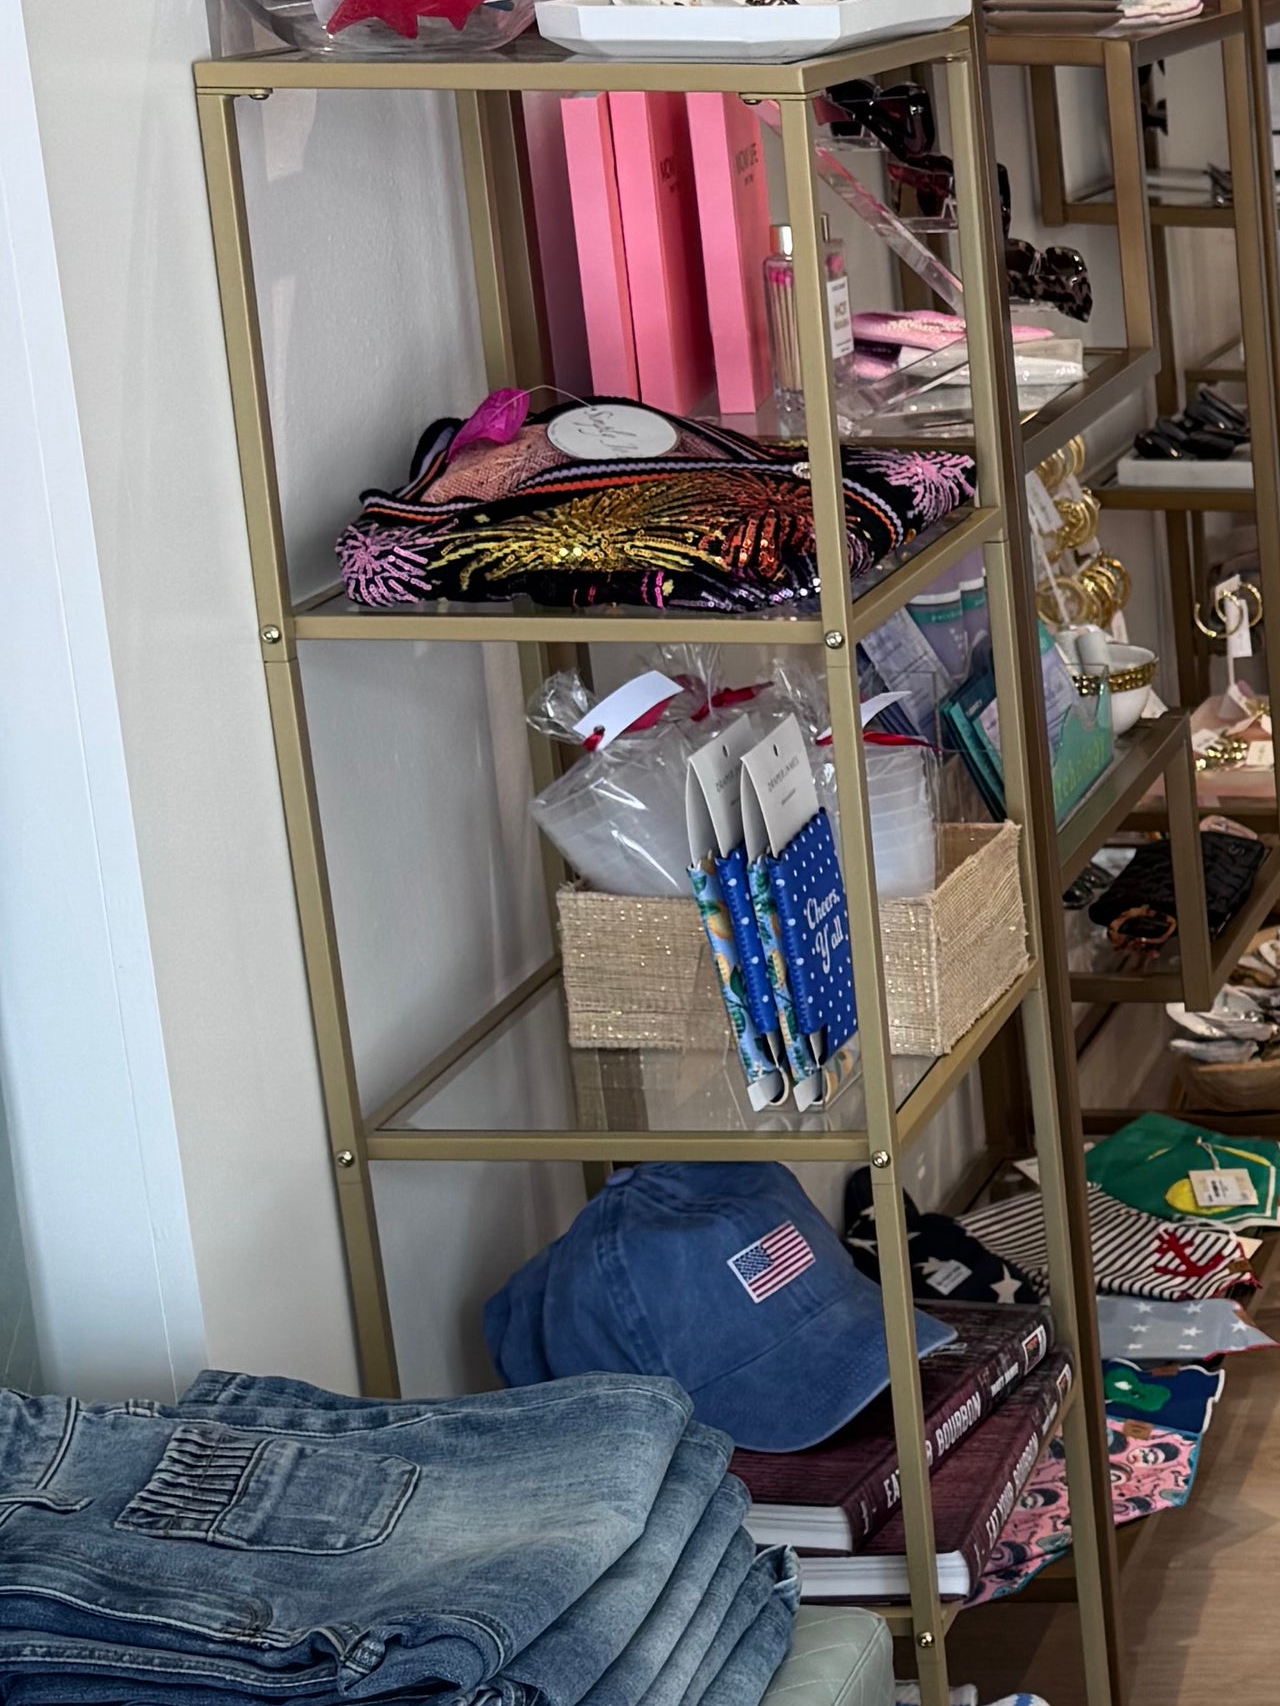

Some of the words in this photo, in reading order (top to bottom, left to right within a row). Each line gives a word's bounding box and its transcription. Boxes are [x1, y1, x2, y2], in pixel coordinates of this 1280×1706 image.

[882, 1468, 901, 1509] EA
[935, 1391, 982, 1458] BOURBON
[985, 1509, 999, 1551] EAT
[1013, 1431, 1040, 1495] BOURBON
